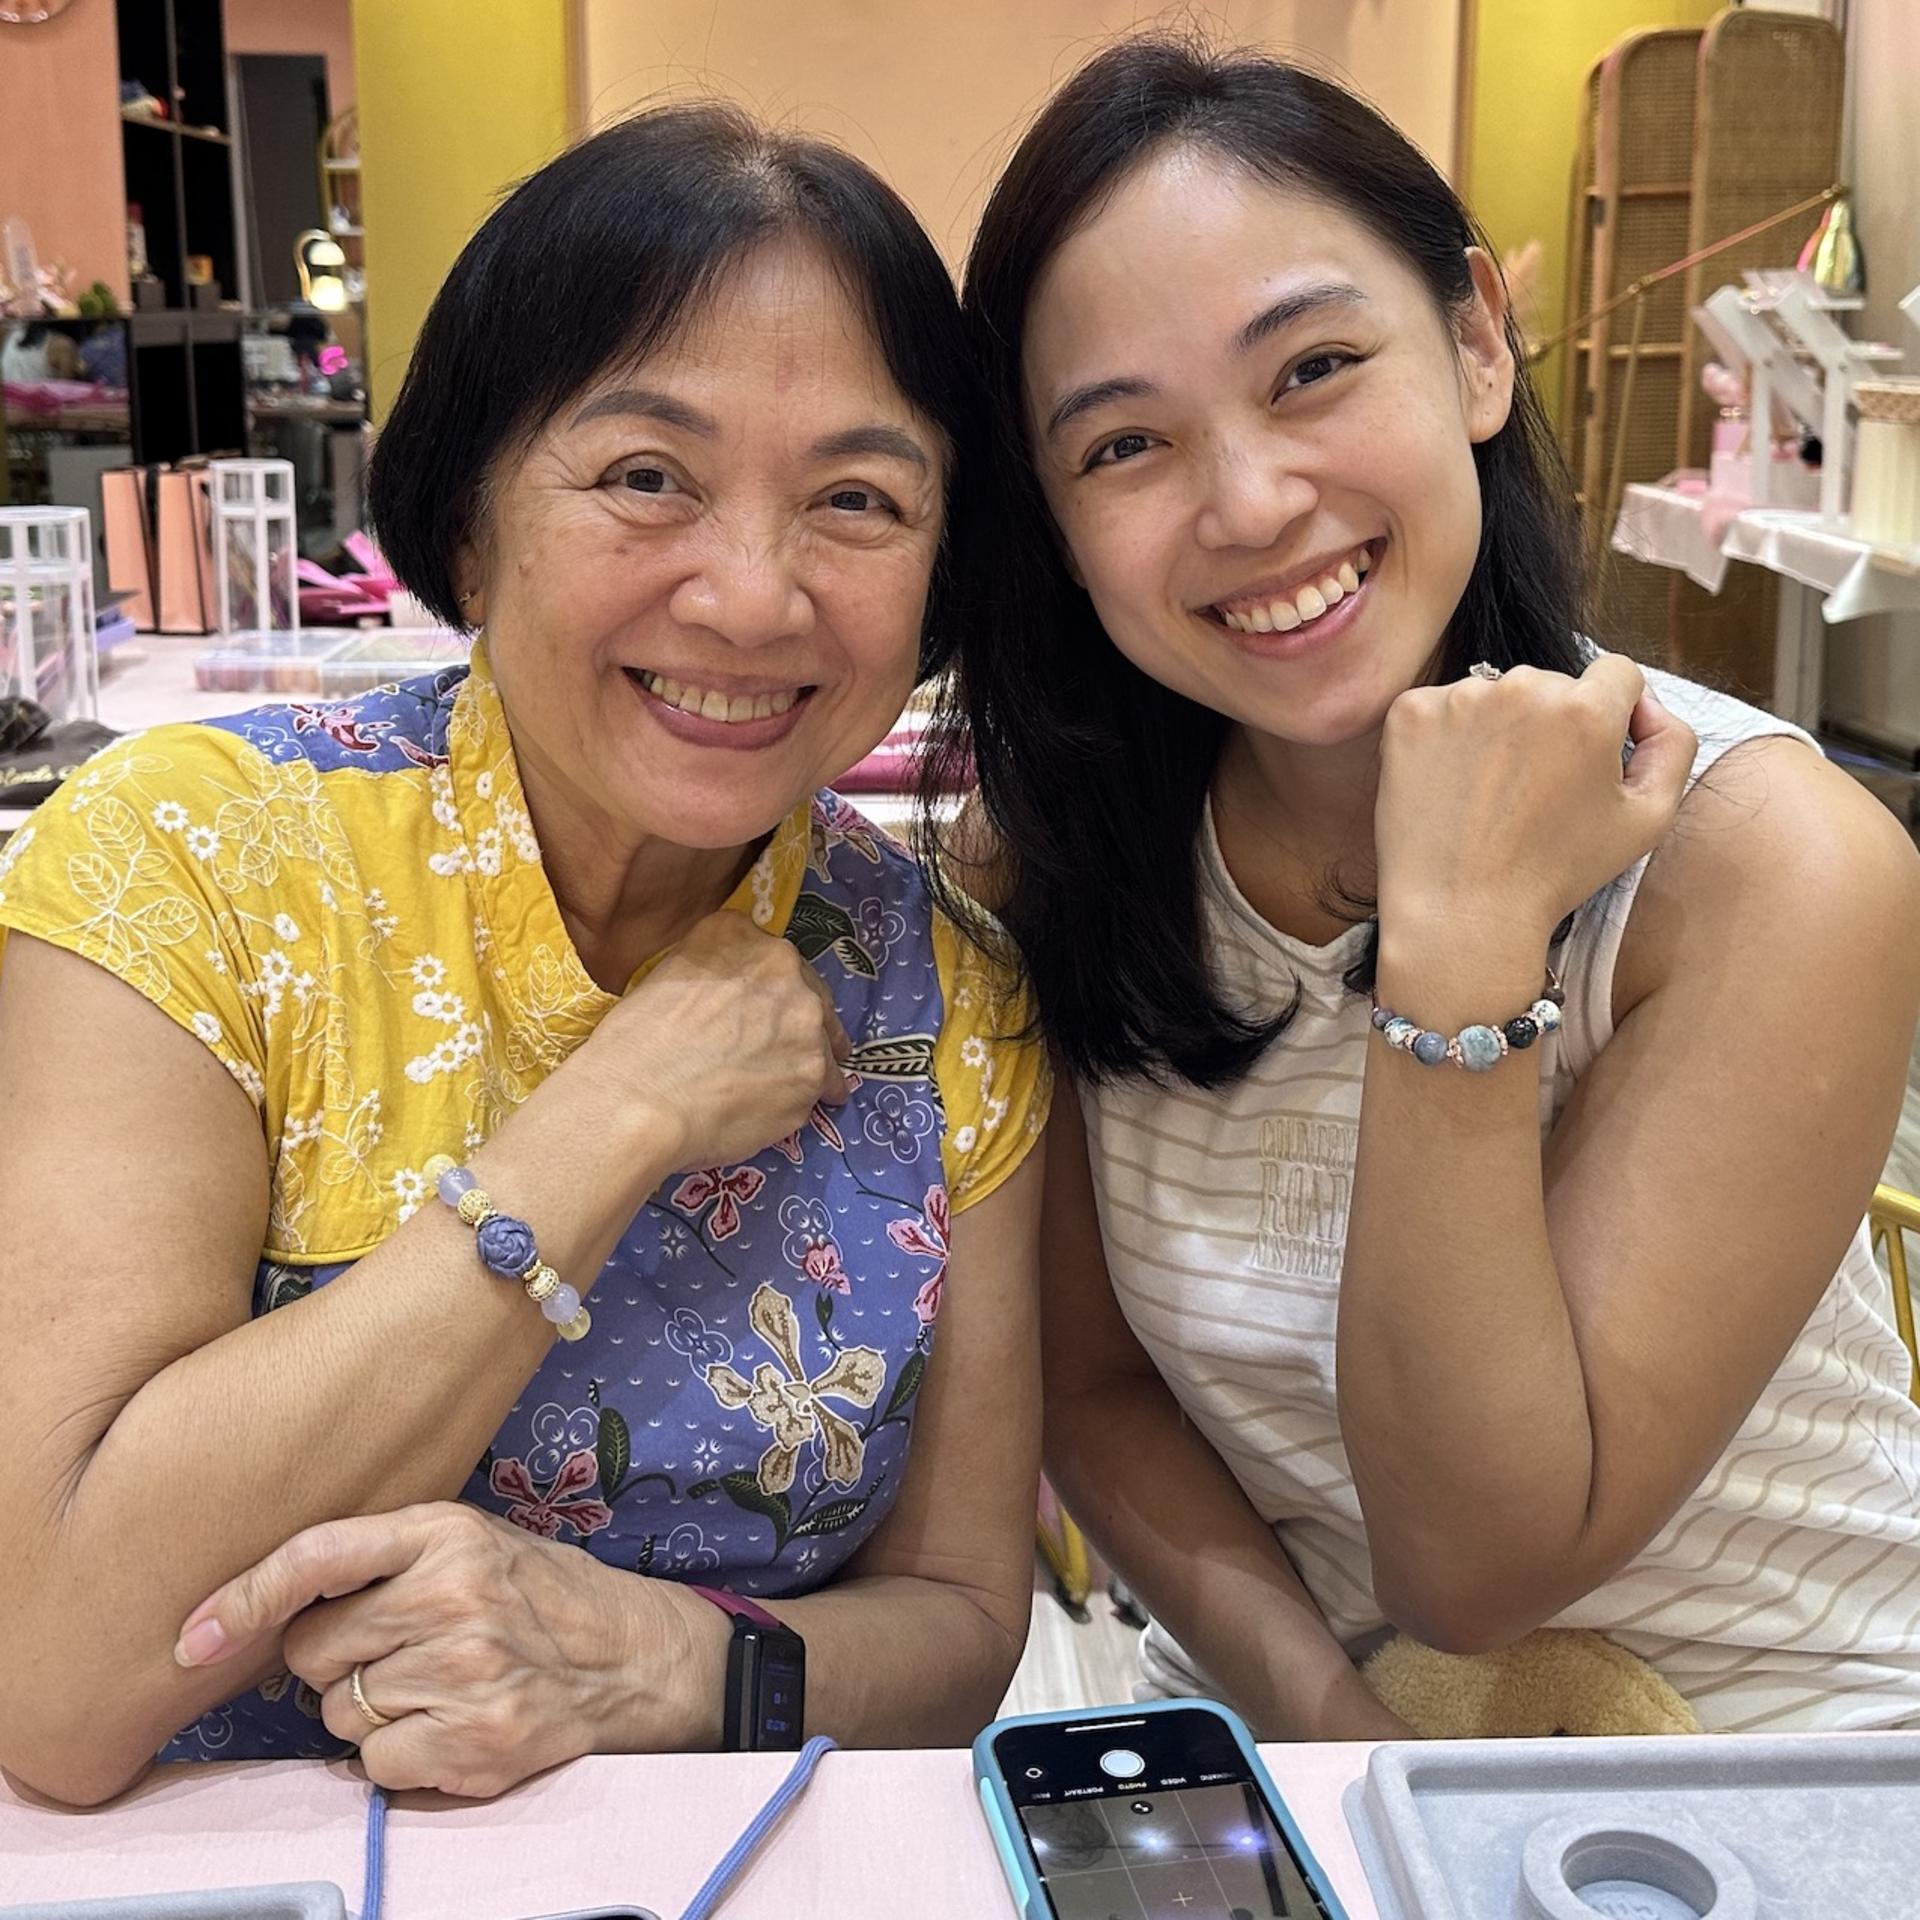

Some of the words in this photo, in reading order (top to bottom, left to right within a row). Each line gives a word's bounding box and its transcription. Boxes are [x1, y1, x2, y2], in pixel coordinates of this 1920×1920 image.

[1257, 1162, 1349, 1243] ROAD
[1117, 1781, 1147, 1790] PHOTO
[1160, 1777, 1187, 1786] VIDEO
[1064, 1786, 1104, 1797] PORTRAIT
